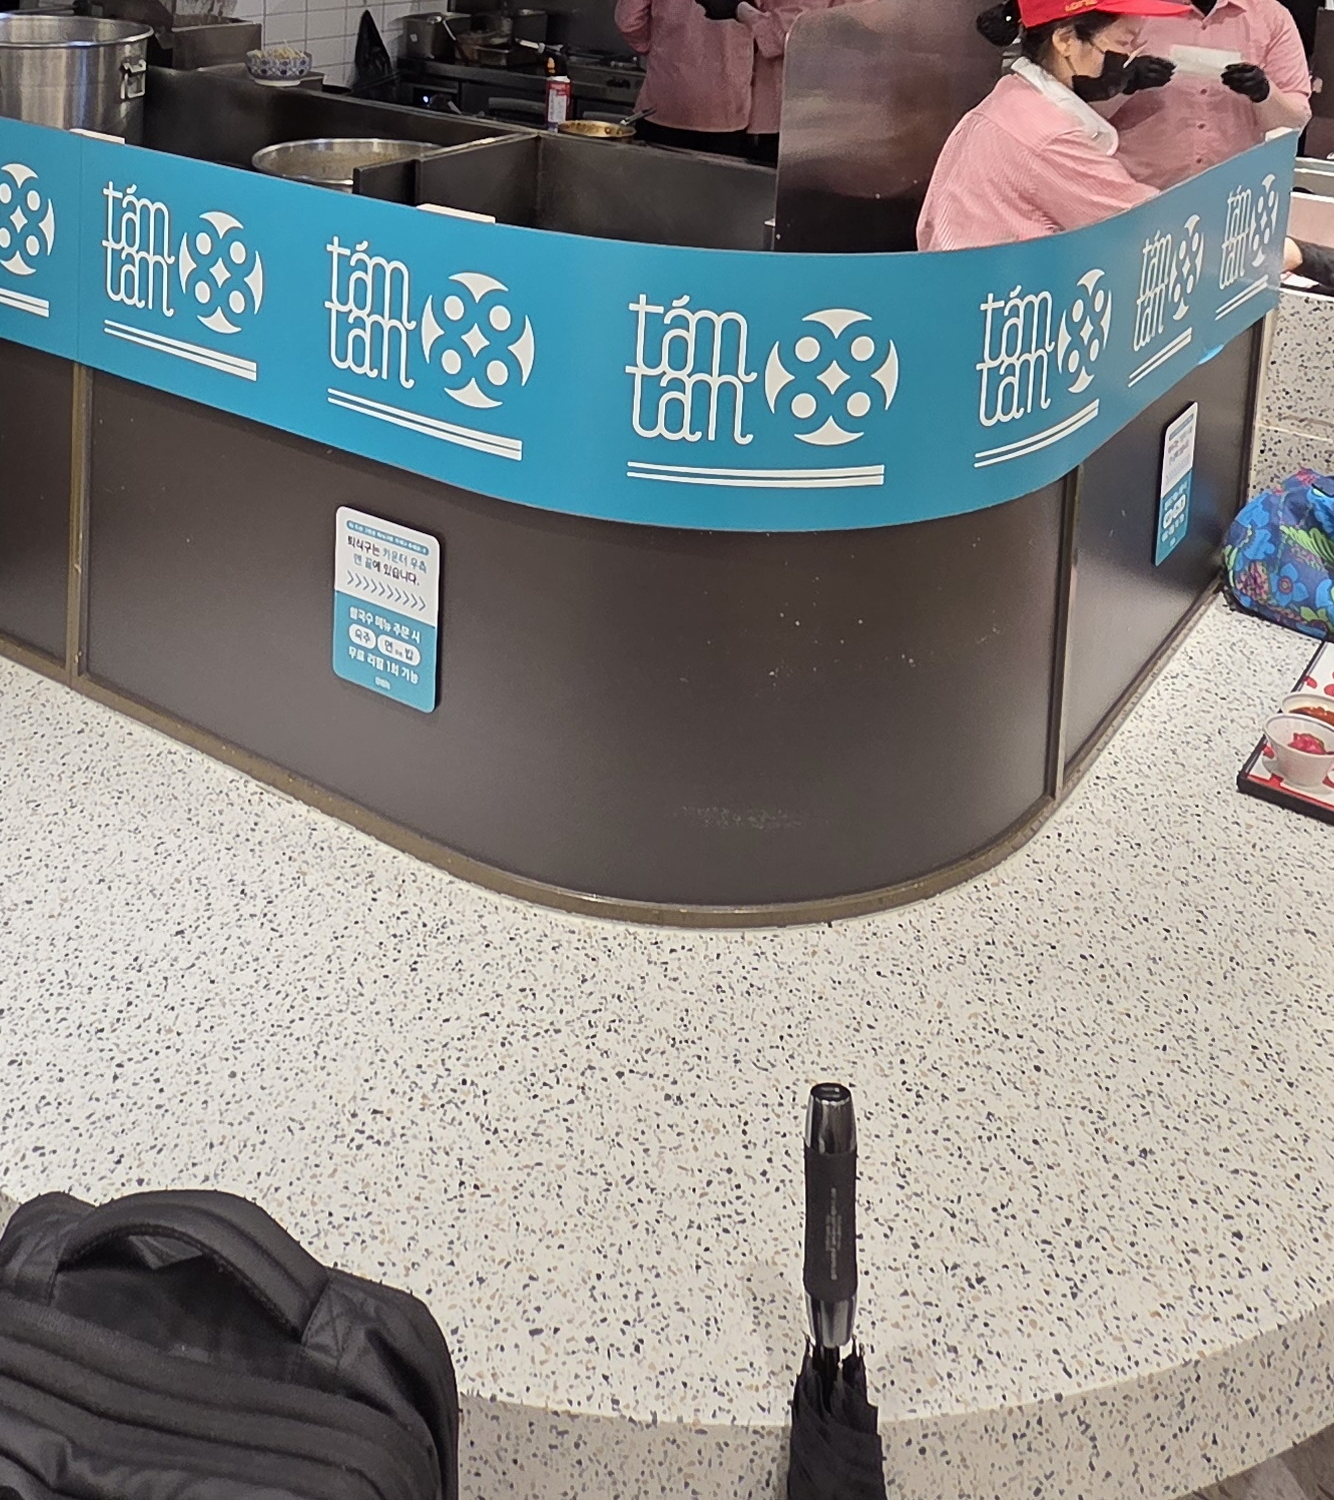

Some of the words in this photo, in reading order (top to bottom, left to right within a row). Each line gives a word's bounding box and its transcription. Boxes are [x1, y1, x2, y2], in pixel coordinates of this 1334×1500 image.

[383, 547, 407, 566] 카운터
[383, 563, 420, 586] 있습니다.
[393, 623, 410, 640] 주문
[411, 630, 420, 644] 시
